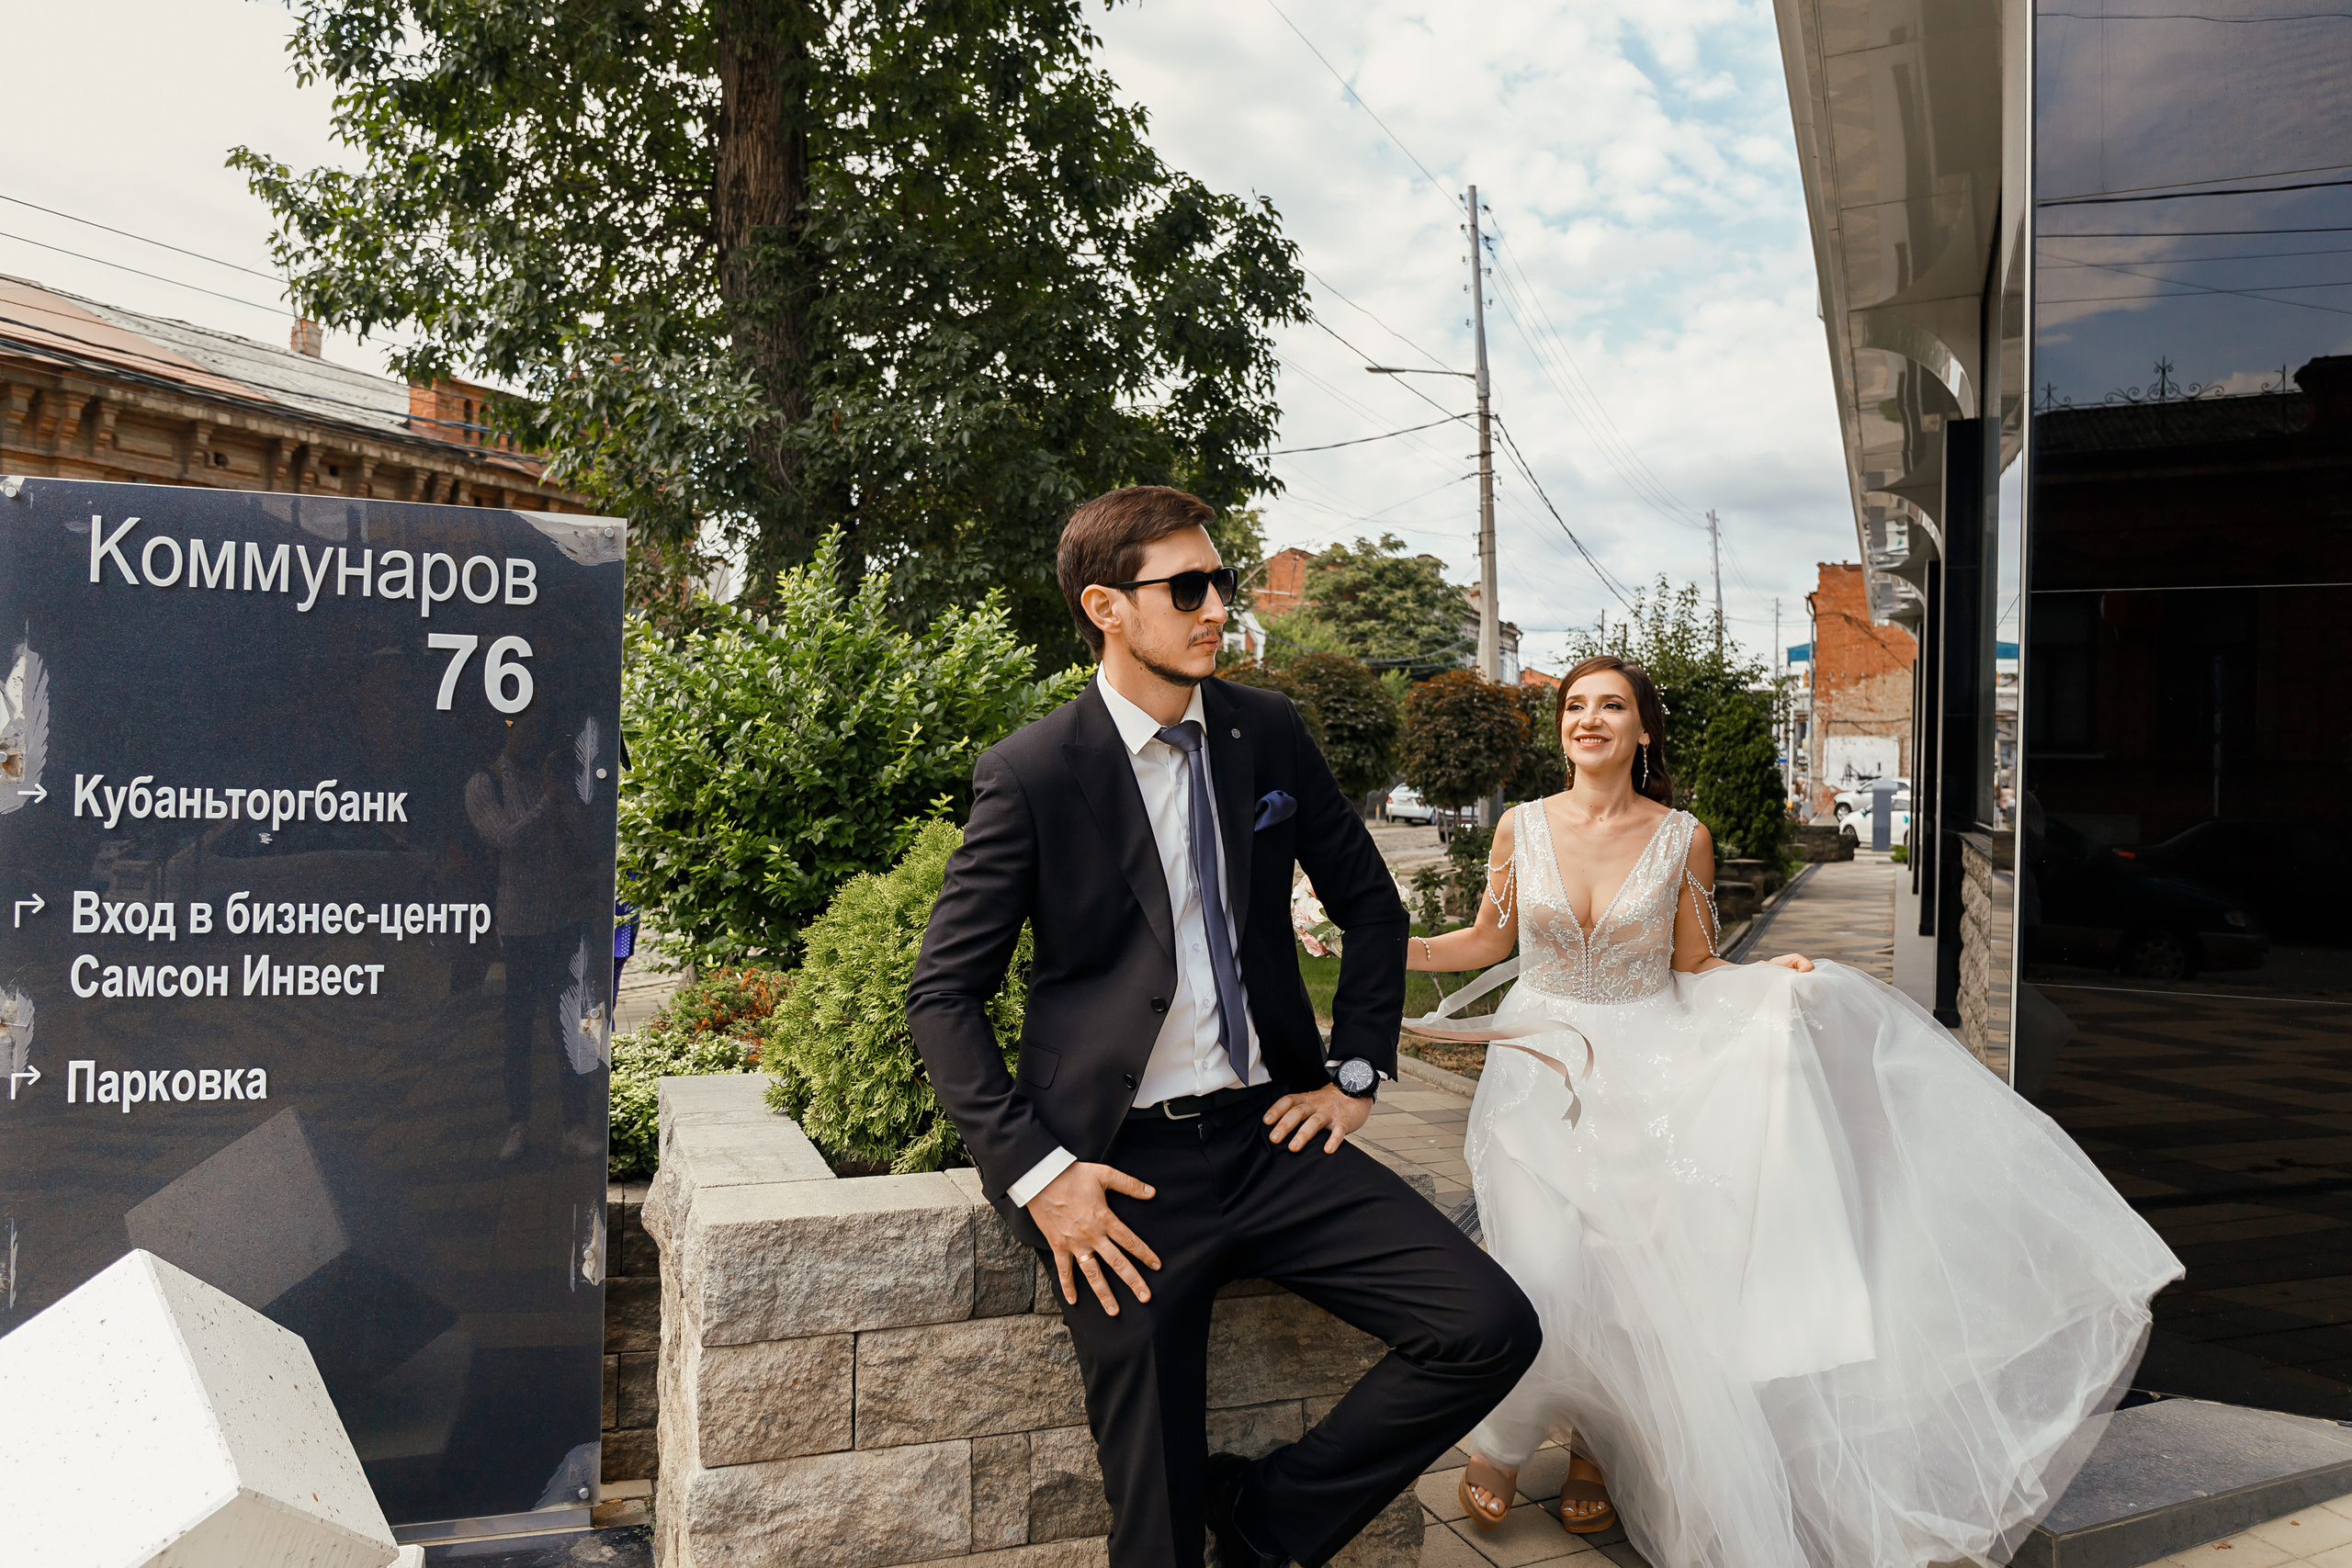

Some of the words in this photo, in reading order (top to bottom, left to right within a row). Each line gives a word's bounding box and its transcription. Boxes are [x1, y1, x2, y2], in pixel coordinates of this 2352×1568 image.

[89, 514, 538, 617] Коммунаров
[427, 632, 534, 714] 76
[74, 773, 408, 831] Кубаньторгбанк
[72, 890, 176, 942] Вход
[189, 902, 213, 934] в
[226, 890, 492, 944] бизнес-центр
[70, 953, 229, 998] Самсон
[243, 954, 385, 997] Инвест
[67, 1059, 267, 1114] Парковка
